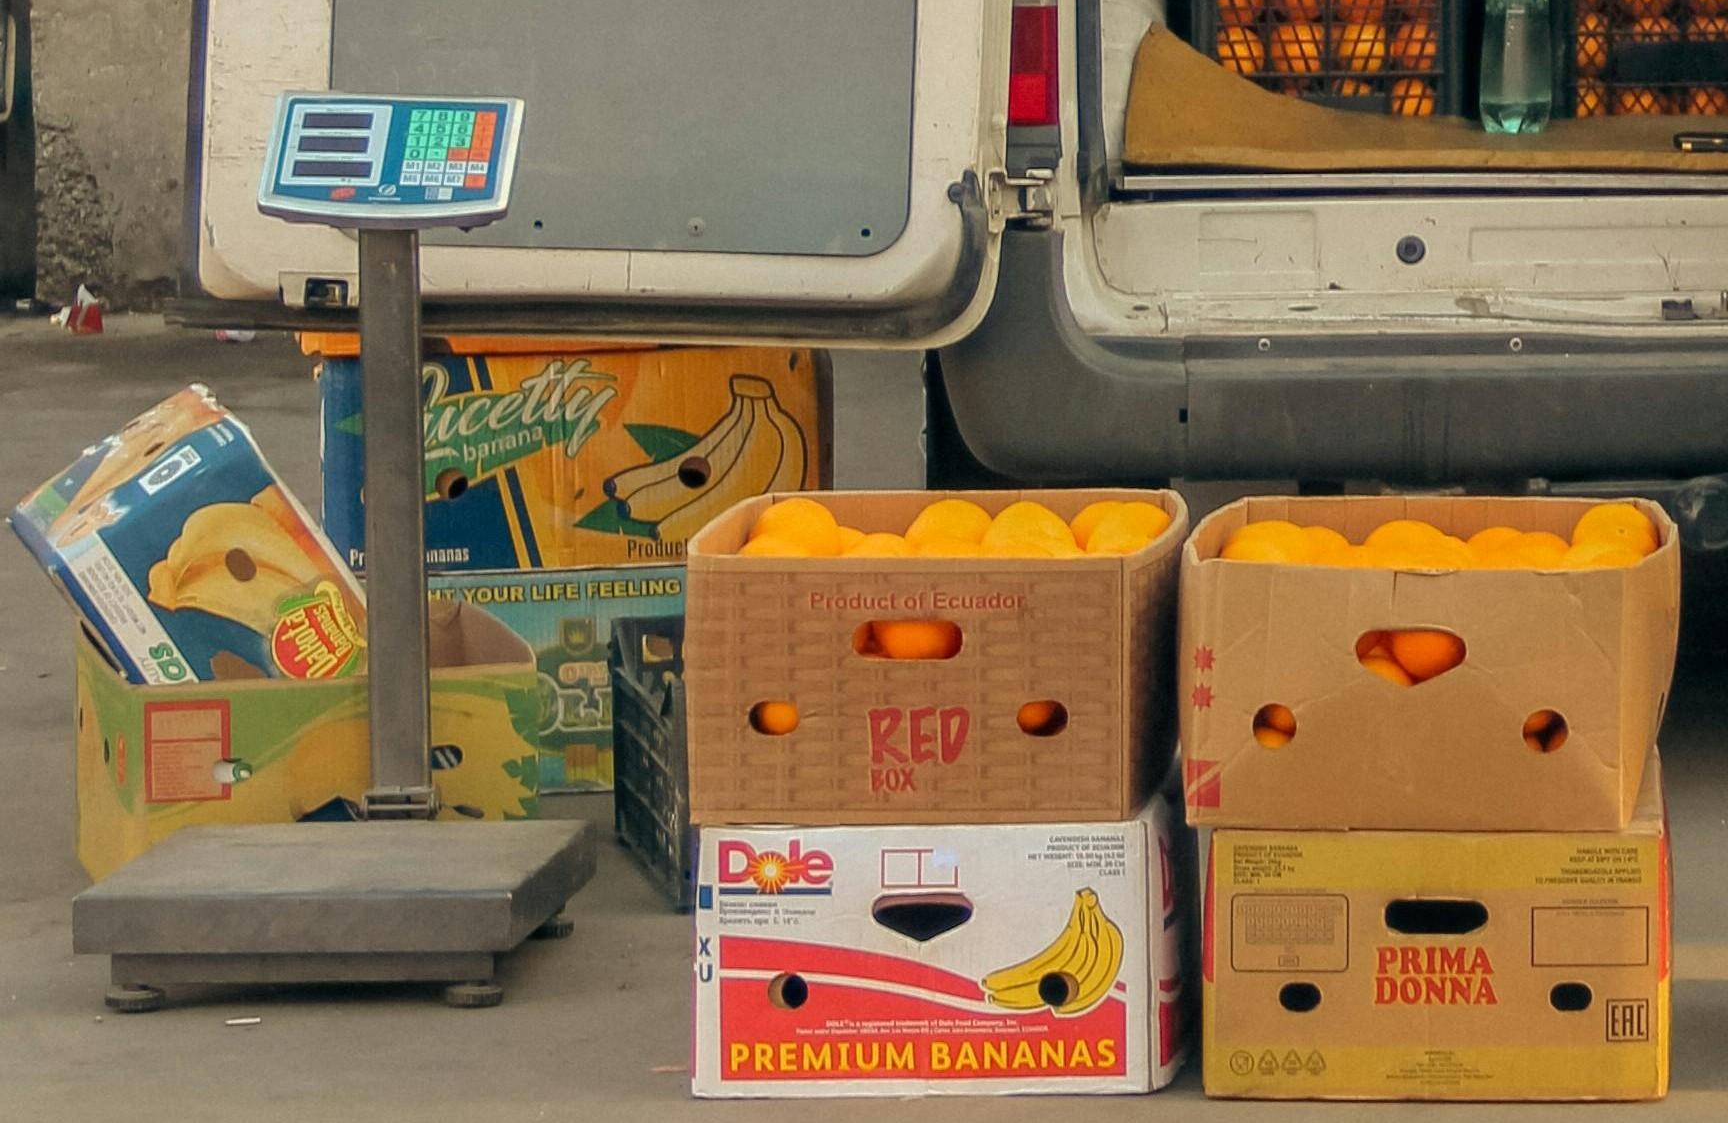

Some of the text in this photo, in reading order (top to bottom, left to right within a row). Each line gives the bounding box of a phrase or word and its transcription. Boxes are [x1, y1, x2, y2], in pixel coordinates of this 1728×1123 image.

[413, 124, 424, 133] 4
[416, 111, 427, 121] 7
[439, 111, 448, 120] 8
[409, 150, 420, 158] 0
[463, 425, 544, 462] banana
[463, 586, 525, 605] YOUR
[531, 583, 581, 602] LIFE
[587, 579, 681, 598] FEELING
[809, 591, 1027, 610] Product of Ecuador
[281, 608, 338, 678] Dakota
[313, 604, 353, 658] Bananas
[868, 706, 970, 765] RED
[871, 768, 918, 793] BOX
[718, 839, 834, 890] Dole
[1376, 946, 1494, 975] PRIMA
[1374, 976, 1498, 1005] DONNA
[1610, 1003, 1645, 1037] EAC
[729, 1038, 1116, 1072] PREMIUM BANANAS
